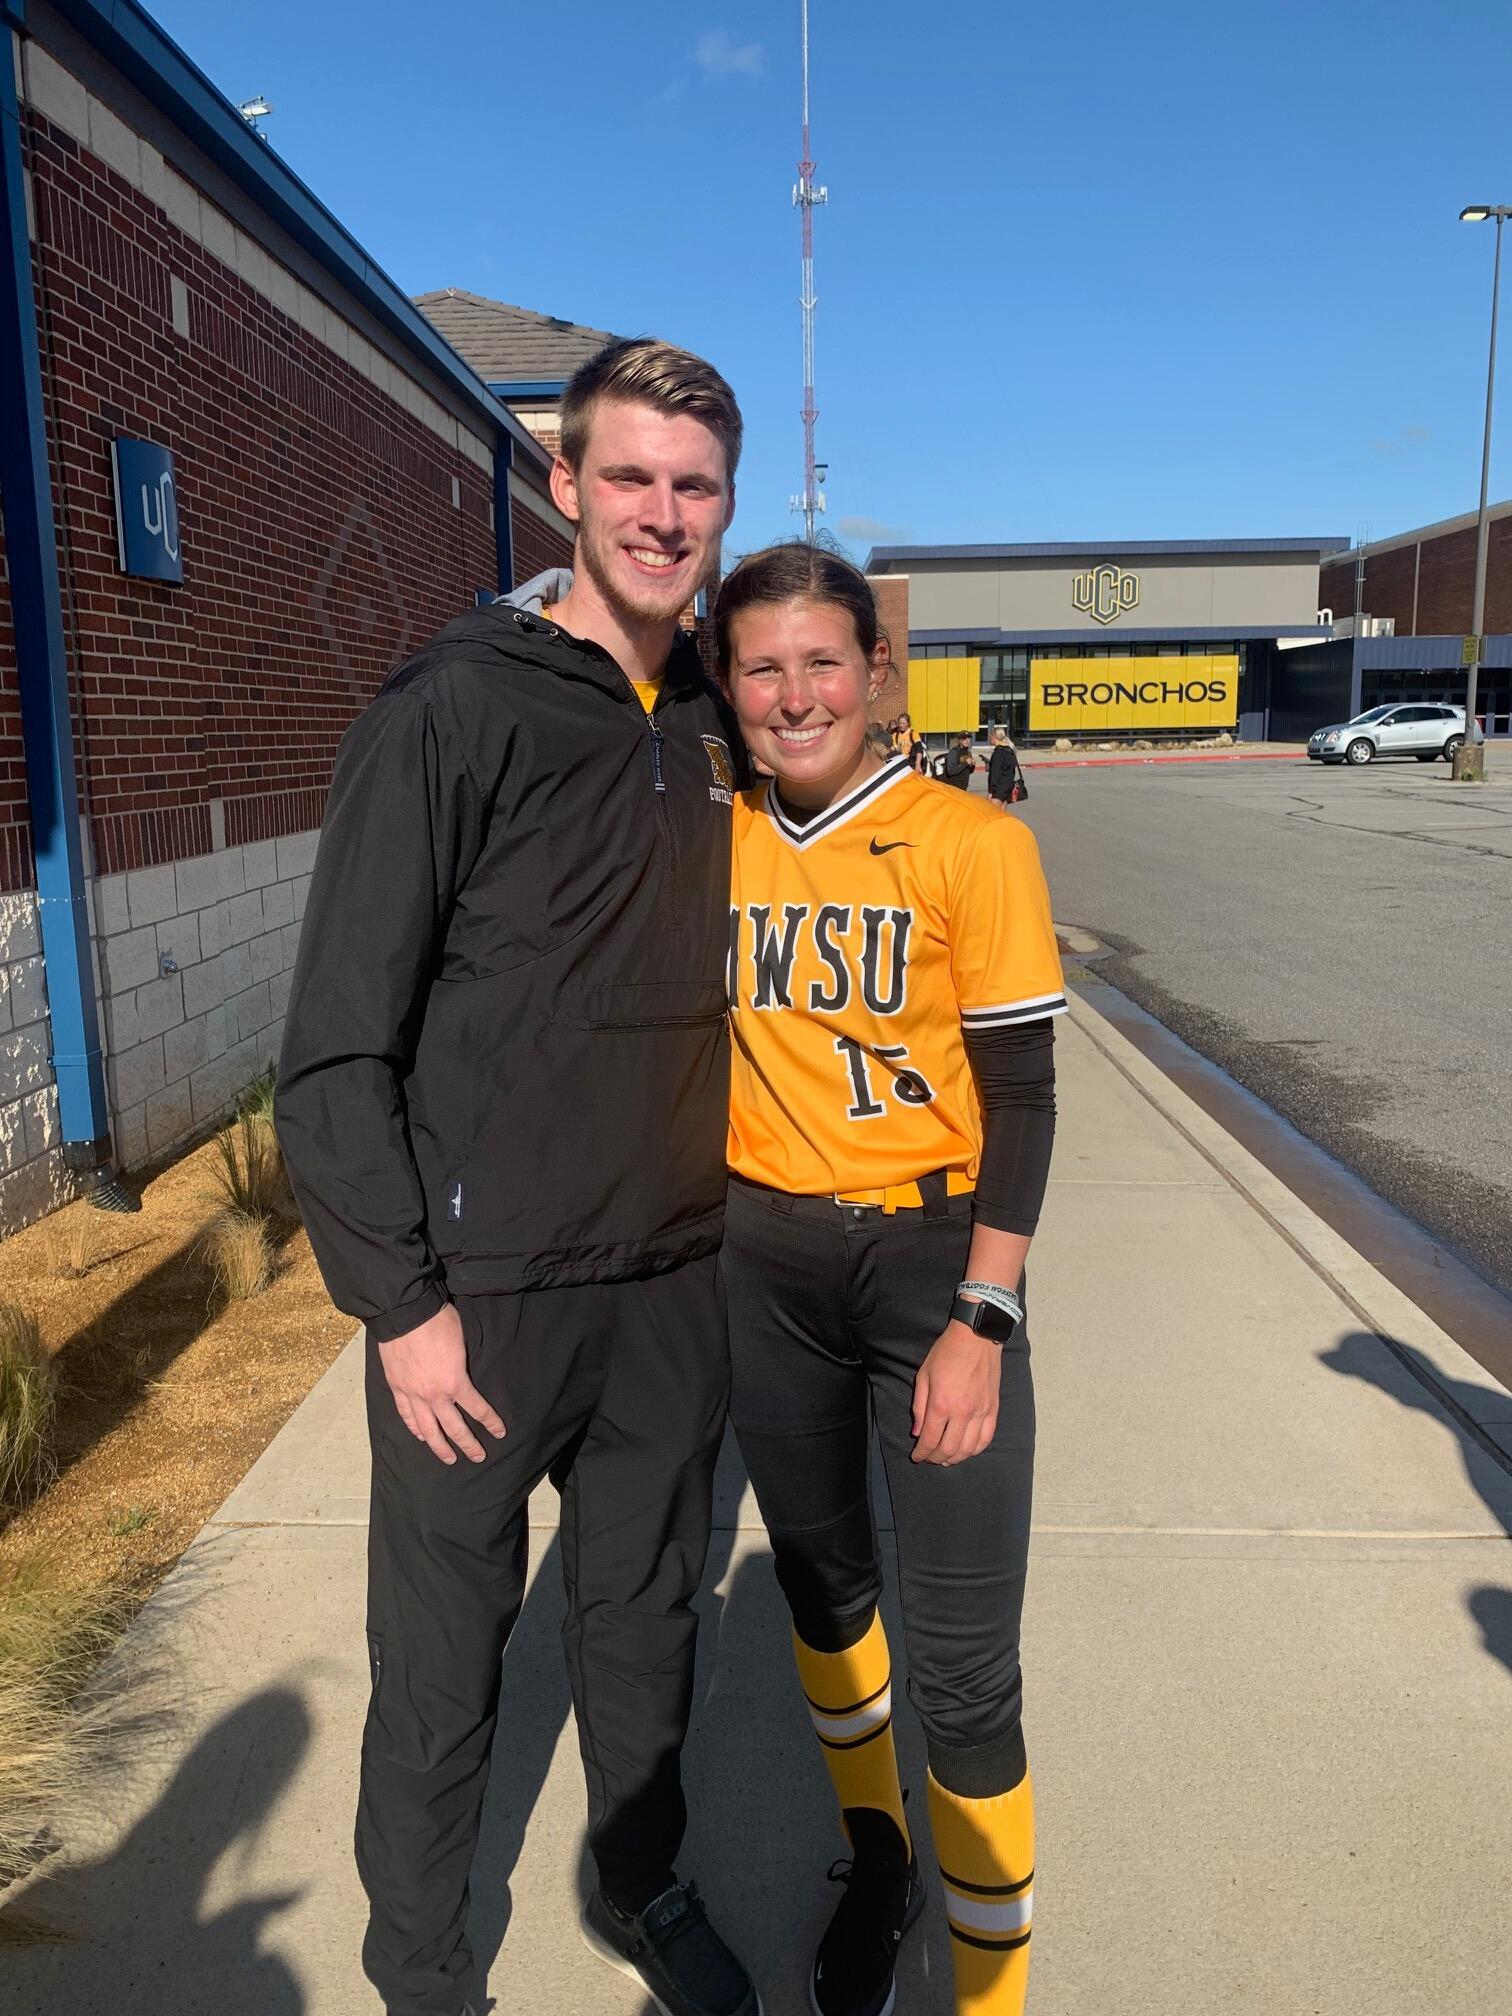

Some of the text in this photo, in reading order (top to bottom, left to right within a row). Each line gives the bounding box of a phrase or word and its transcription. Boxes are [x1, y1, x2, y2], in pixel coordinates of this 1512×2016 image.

[1072, 562, 1140, 625] UCO
[1041, 680, 1226, 706] BRONCHOS
[833, 1035, 937, 1121] 15
